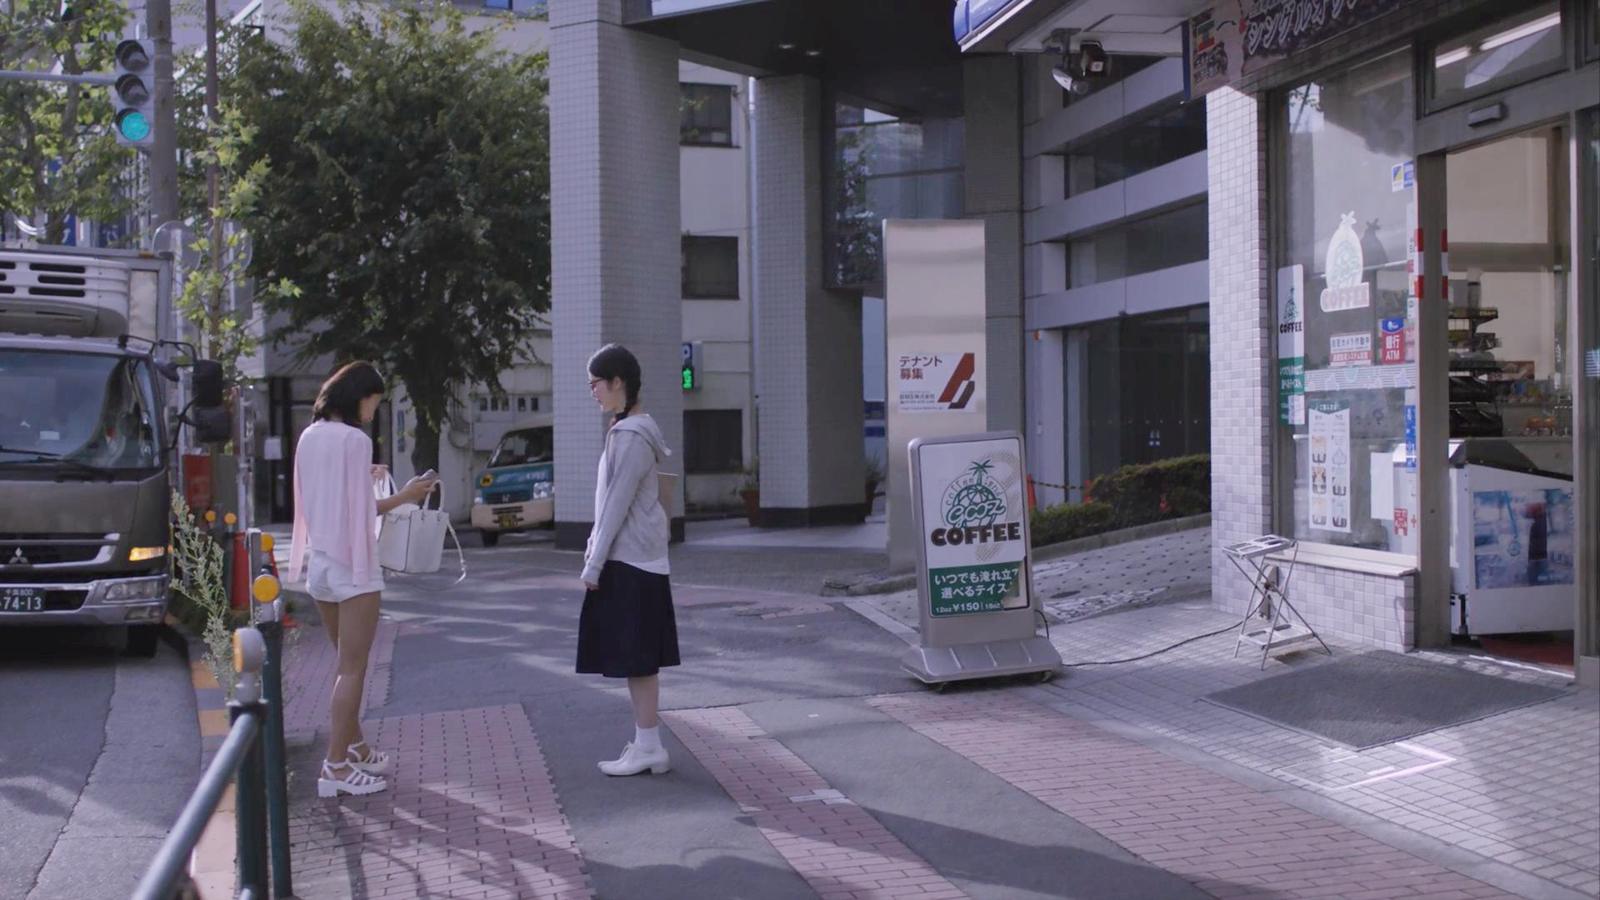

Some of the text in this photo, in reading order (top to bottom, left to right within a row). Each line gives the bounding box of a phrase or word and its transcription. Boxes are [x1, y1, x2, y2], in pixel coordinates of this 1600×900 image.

[1280, 321, 1303, 334] COFFEE
[1386, 334, 1400, 349] 銀行
[899, 355, 943, 367] テナント
[1385, 349, 1400, 361] ATM
[900, 368, 924, 380] 募集
[930, 522, 1021, 547] COFFEE
[941, 582, 1012, 599] 選べるテイス
[3, 596, 42, 611] 74-13
[953, 602, 980, 612] ¥150
